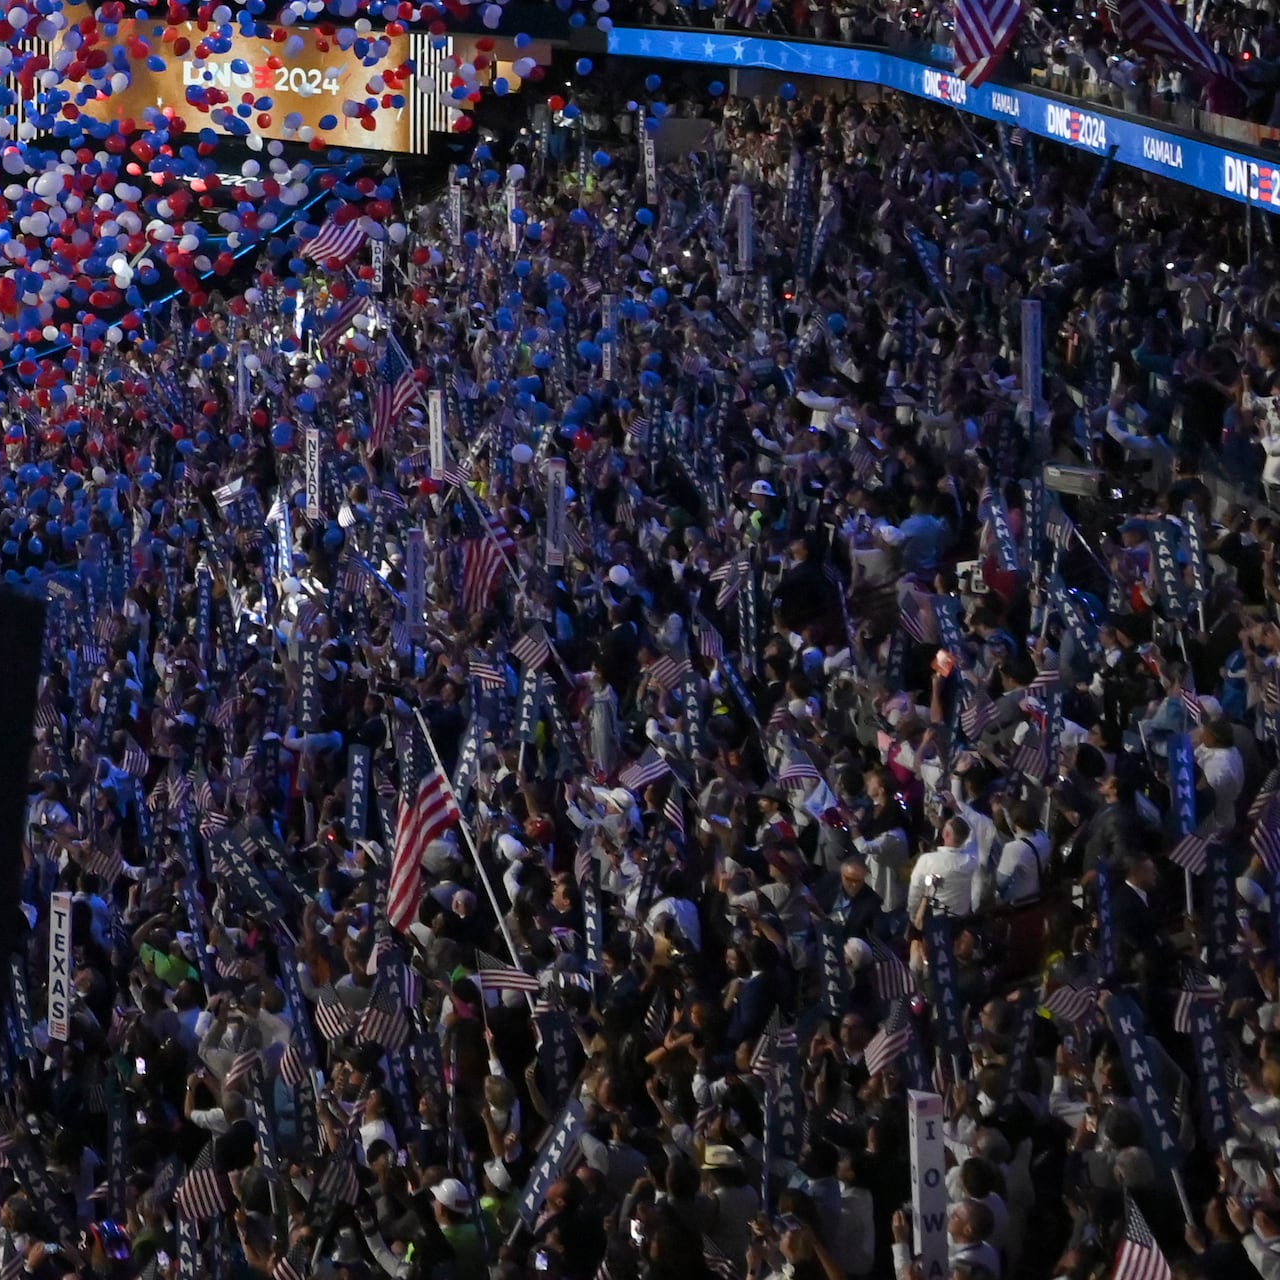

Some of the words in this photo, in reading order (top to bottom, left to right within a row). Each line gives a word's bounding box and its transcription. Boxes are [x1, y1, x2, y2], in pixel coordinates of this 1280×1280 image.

[992, 91, 1020, 117] KAMALA
[646, 147, 656, 193] GUAM
[1143, 136, 1183, 169] KAMALA
[307, 440, 317, 508] NEVADA
[1154, 531, 1183, 609] KAMALA
[1187, 509, 1204, 593] KAMALA
[197, 577, 209, 637] KAMALA
[304, 650, 315, 724] KAMALA
[520, 669, 537, 733] AMALA
[351, 754, 364, 831] KAMALA
[221, 839, 277, 912] KAMALA
[258, 835, 313, 904] KAMALA
[1213, 858, 1228, 962] KAMALA
[52, 911, 67, 1020] TEXAS
[933, 931, 959, 1042] KAMALA
[11, 963, 33, 1050] KAMALA
[1119, 1016, 1175, 1152] KAMALA
[1197, 1017, 1225, 1132] KAMALA
[526, 1114, 577, 1212] KAMALA
[924, 1122, 943, 1280] IOWA
